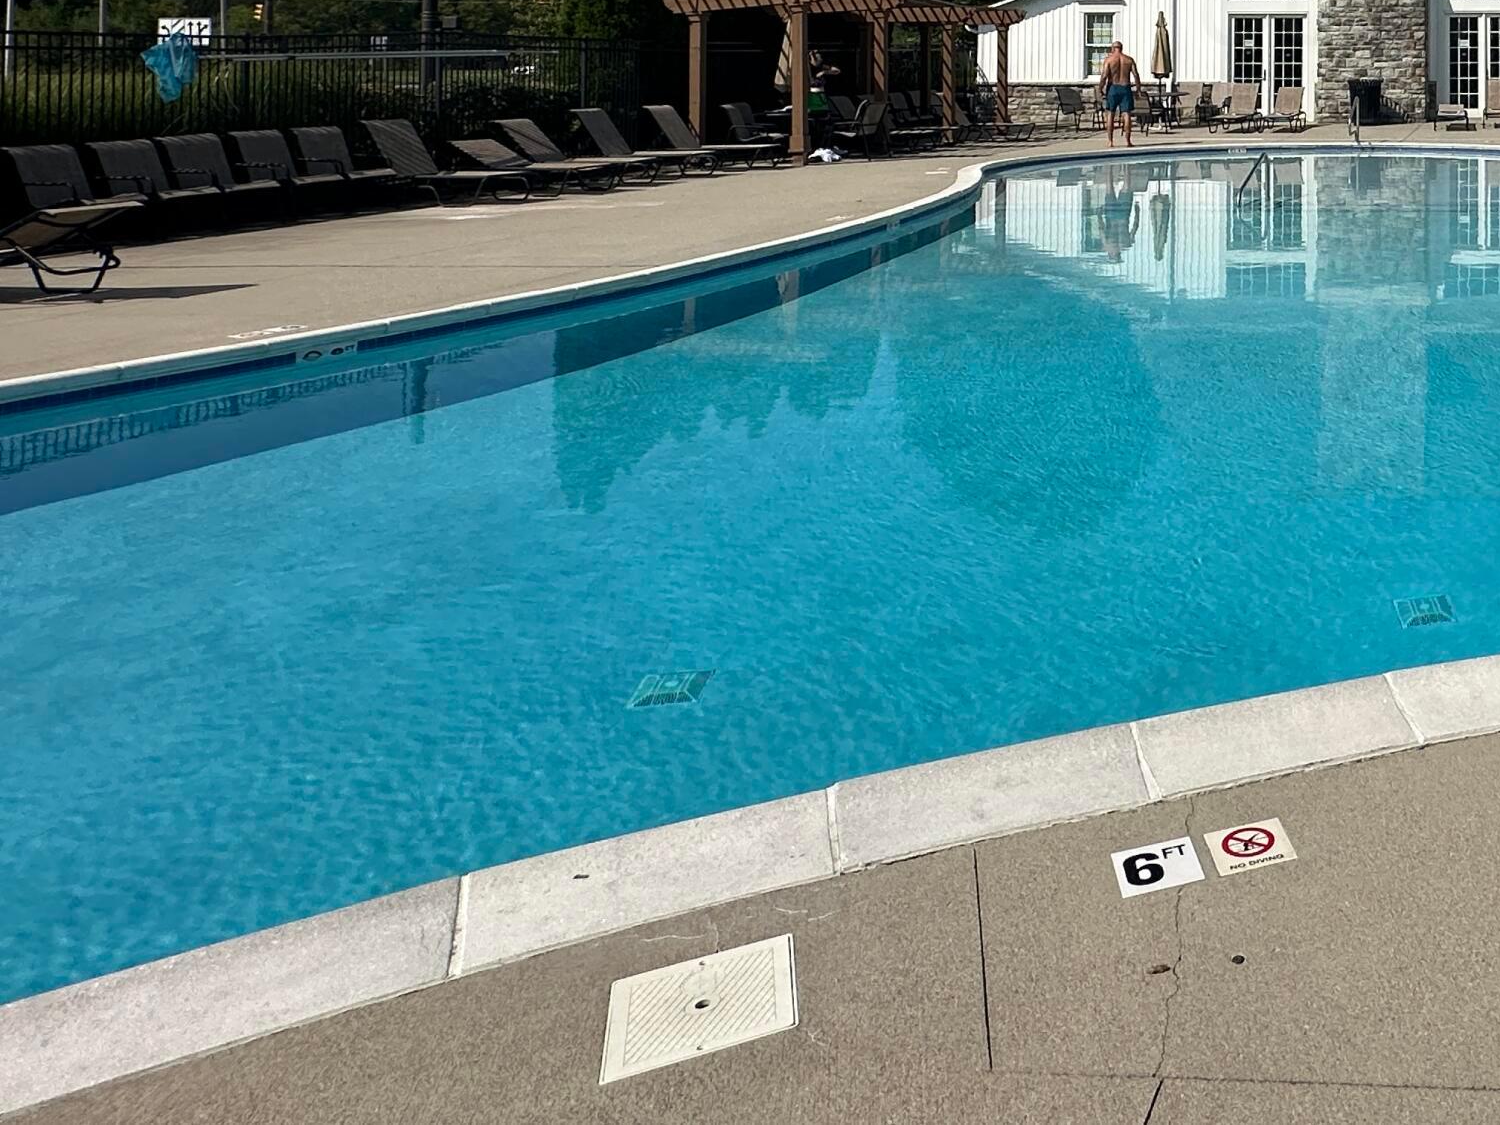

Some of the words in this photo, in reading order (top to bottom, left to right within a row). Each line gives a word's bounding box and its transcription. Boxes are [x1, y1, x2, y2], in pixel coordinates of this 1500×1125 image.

[1122, 852, 1165, 886] 6
[1161, 844, 1186, 860] FT
[1229, 862, 1247, 871] NO
[1248, 854, 1284, 866] DIVING
